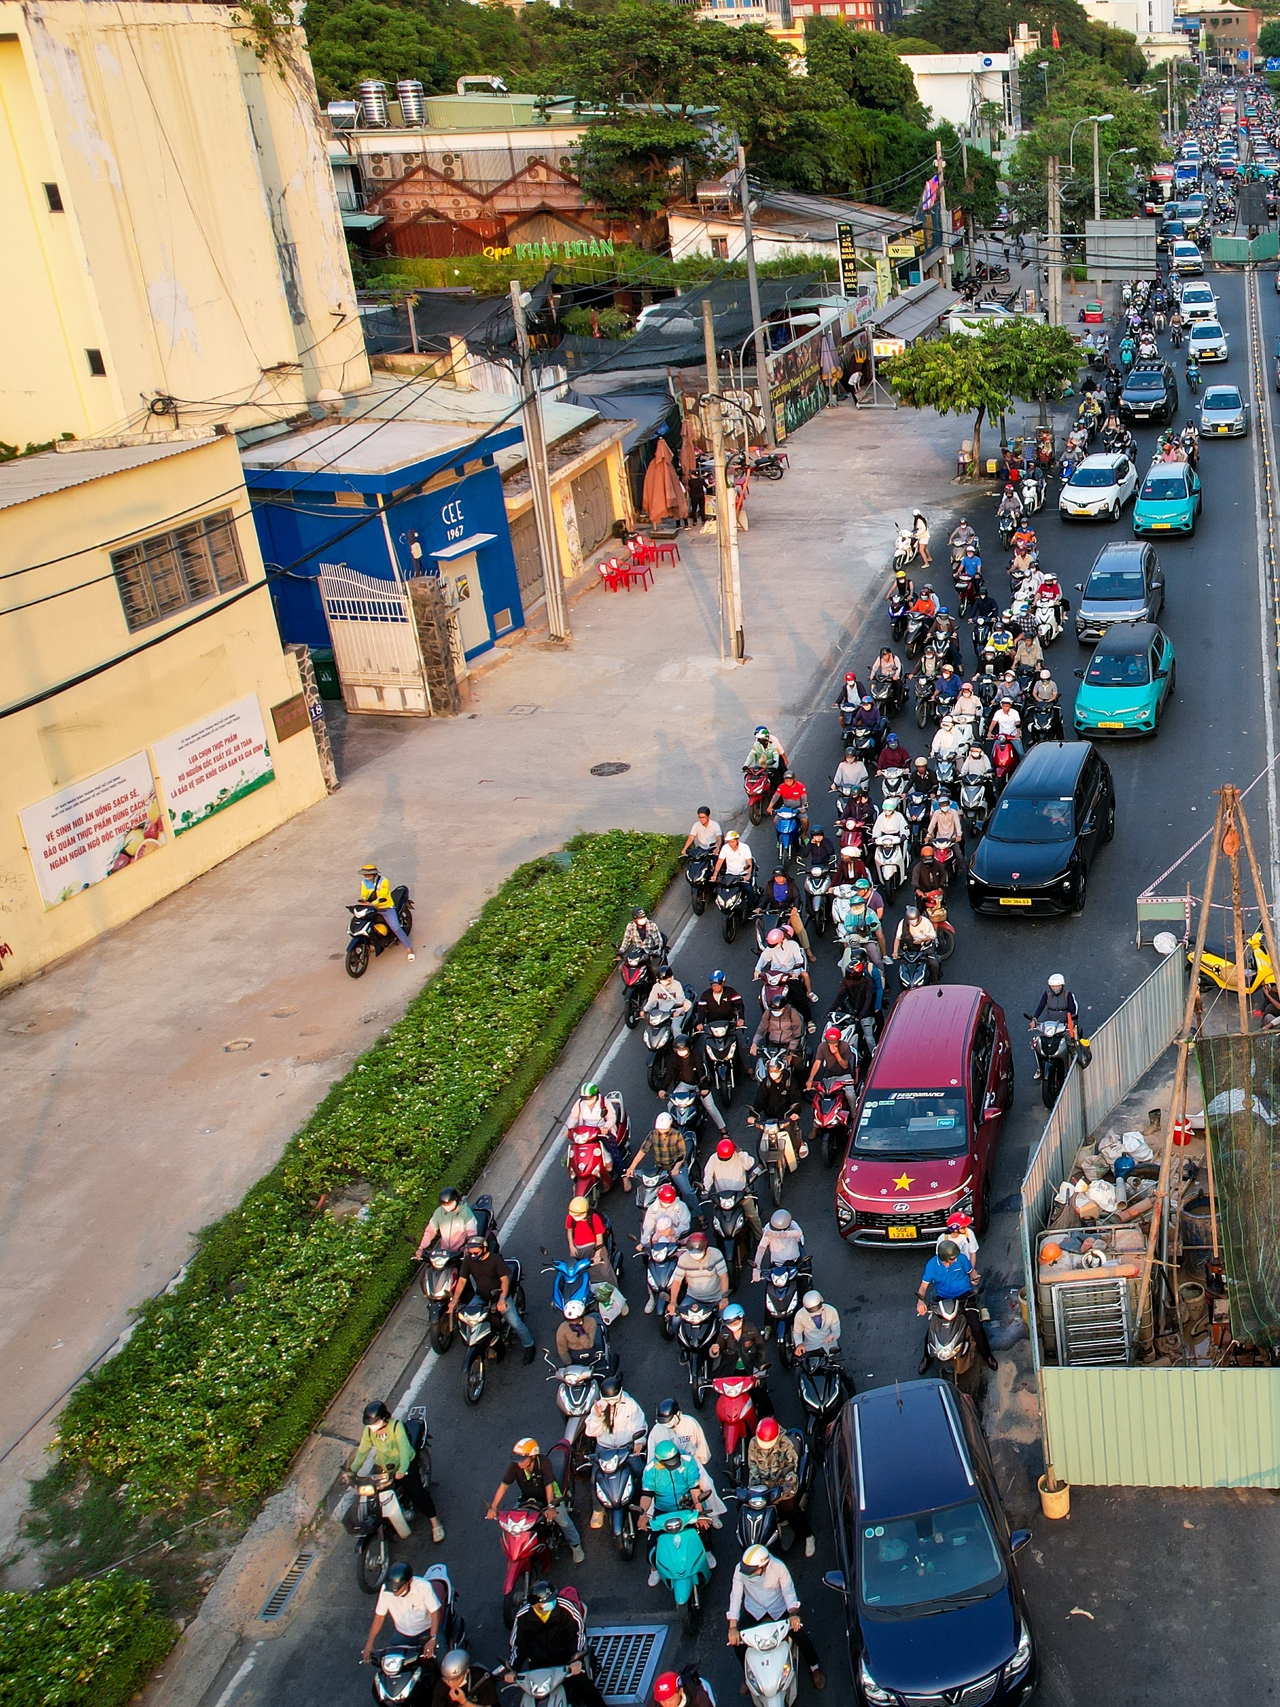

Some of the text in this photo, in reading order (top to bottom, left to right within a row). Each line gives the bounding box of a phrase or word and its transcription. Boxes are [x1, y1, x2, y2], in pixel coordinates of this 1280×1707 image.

[482, 246, 512, 261] Spa
[441, 500, 464, 525] CEE
[446, 525, 464, 541] 1967
[310, 704, 323, 718] 18
